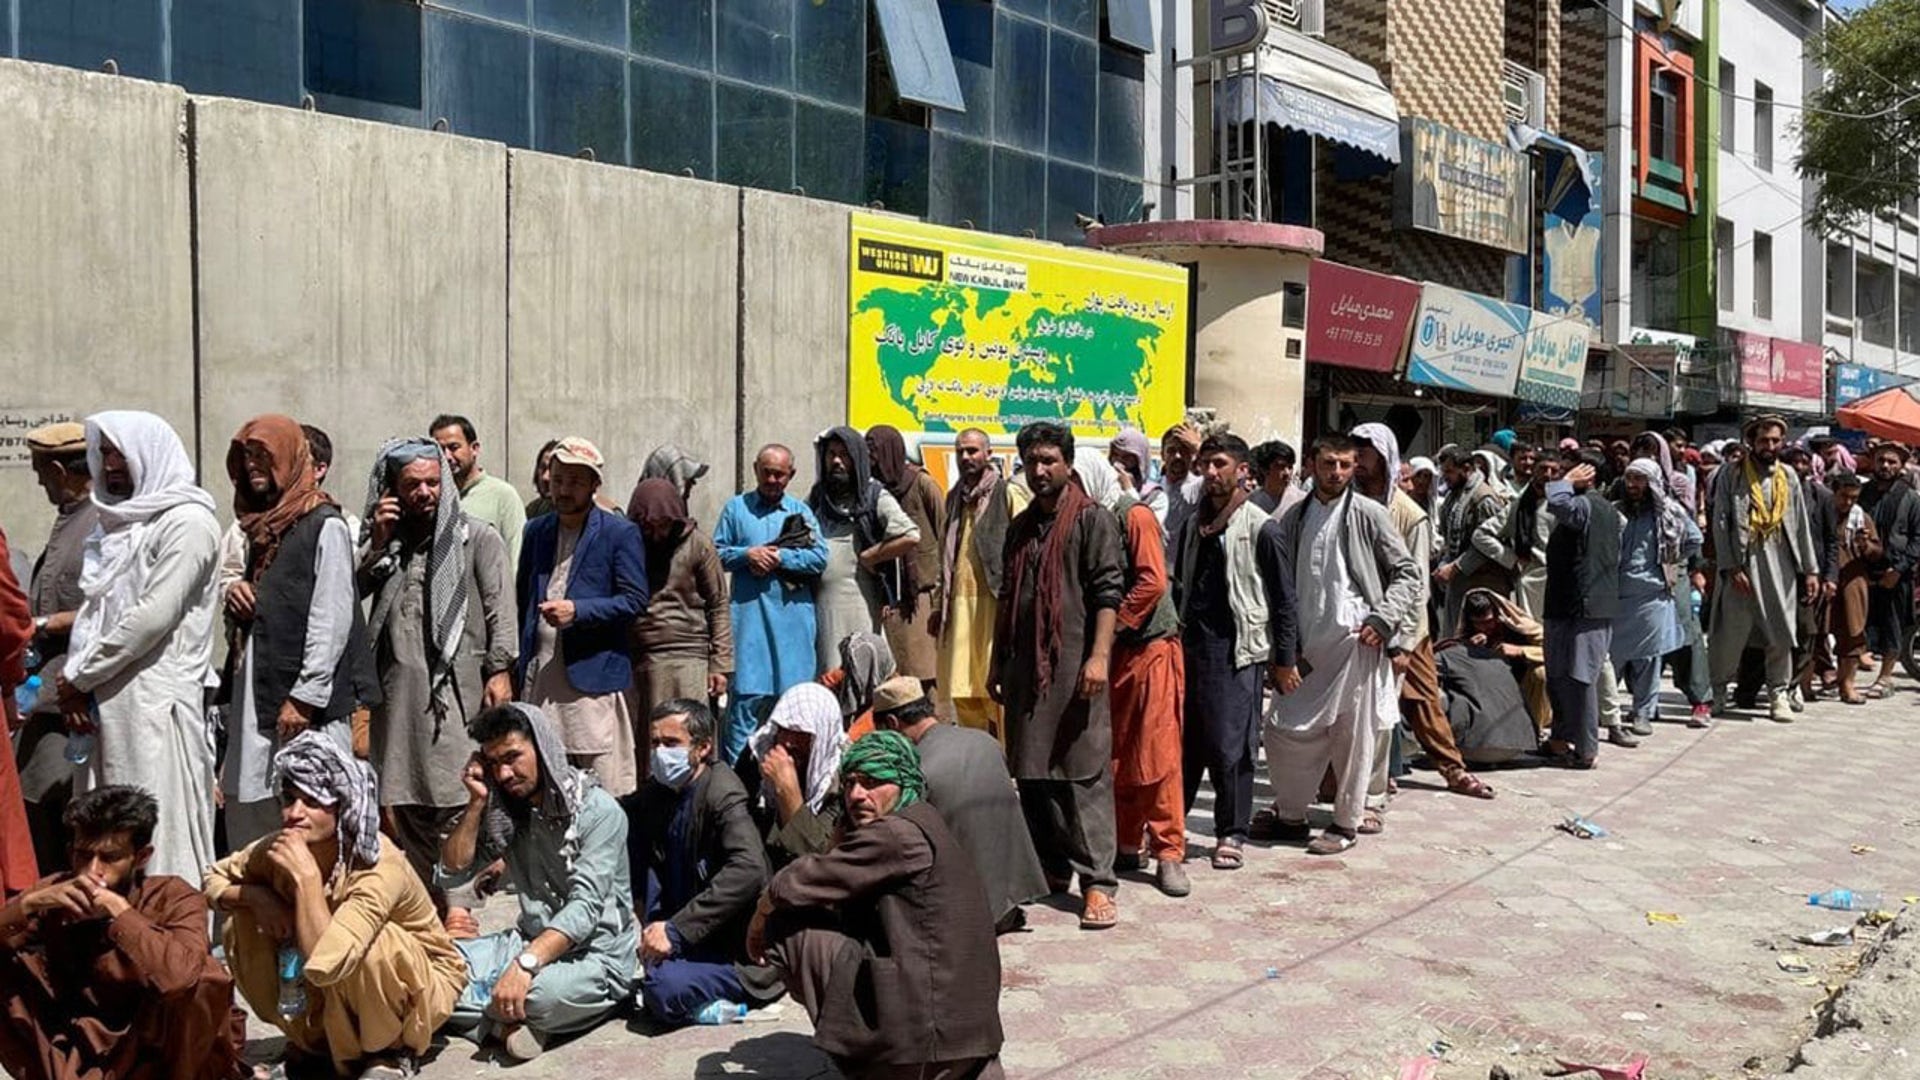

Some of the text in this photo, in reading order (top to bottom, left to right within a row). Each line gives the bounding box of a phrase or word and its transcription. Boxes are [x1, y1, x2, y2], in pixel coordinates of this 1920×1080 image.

[861, 246, 939, 275] WESTERN WU
[876, 259, 908, 271] UNION
[950, 271, 1027, 291] NEW KABUL BANK
[1107, 295, 1139, 316] دریافت
[1149, 300, 1175, 321] ارسال
[1330, 294, 1360, 318] مبایل
[1358, 303, 1395, 321] محمدی
[874, 323, 905, 351] بانک
[908, 327, 939, 356] کابل
[940, 336, 965, 358] نوی
